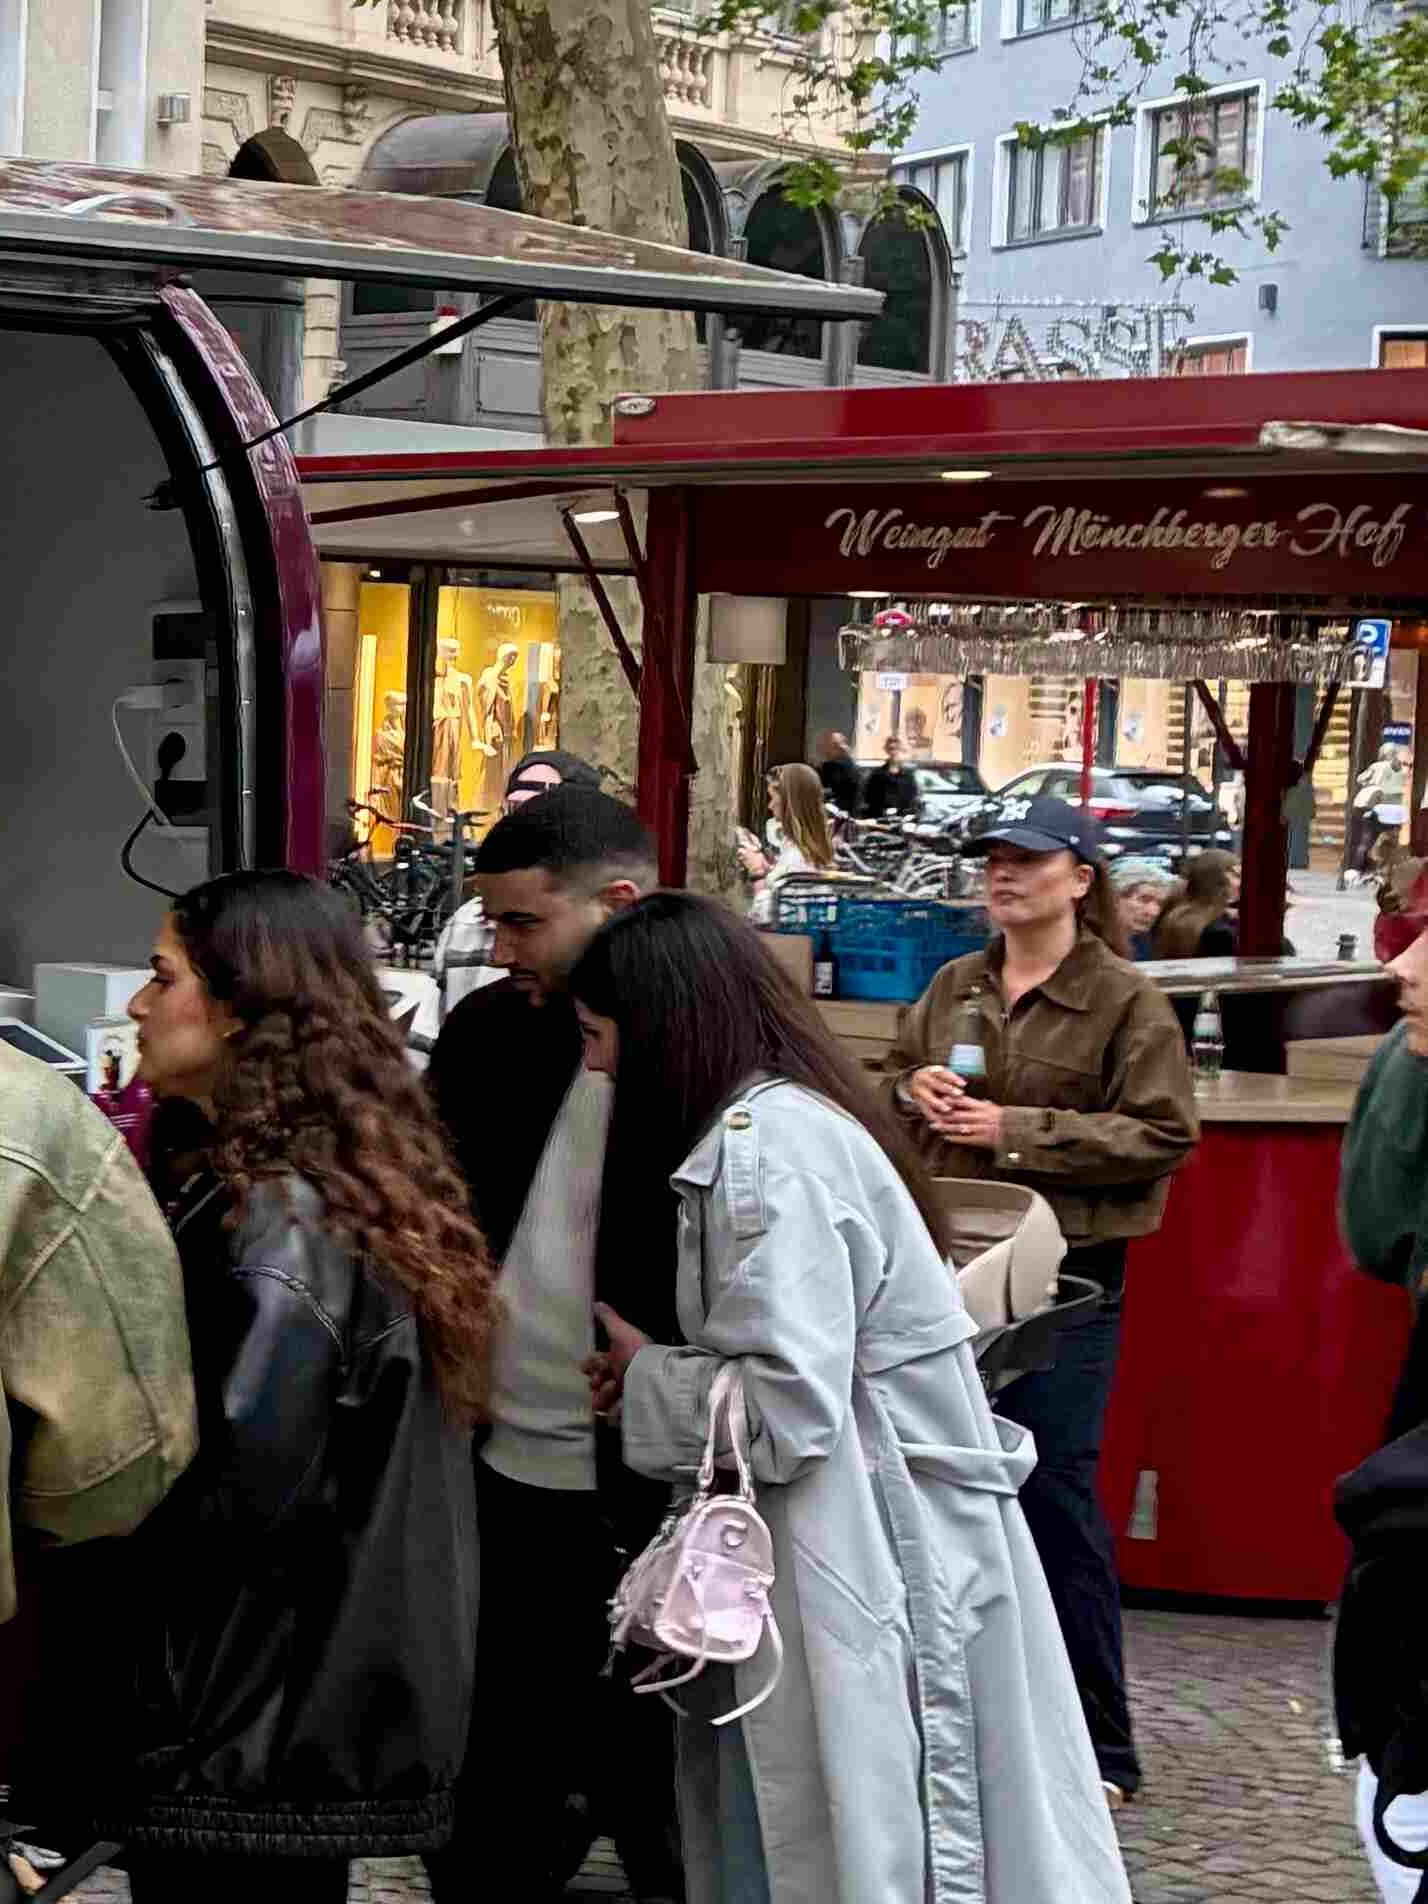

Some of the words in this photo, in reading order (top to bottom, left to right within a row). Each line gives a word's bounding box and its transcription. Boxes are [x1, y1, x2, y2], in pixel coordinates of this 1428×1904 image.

[823, 507, 1016, 569] Weingut
[1022, 504, 1285, 569] Mönchberger
[1289, 502, 1414, 569] Hof
